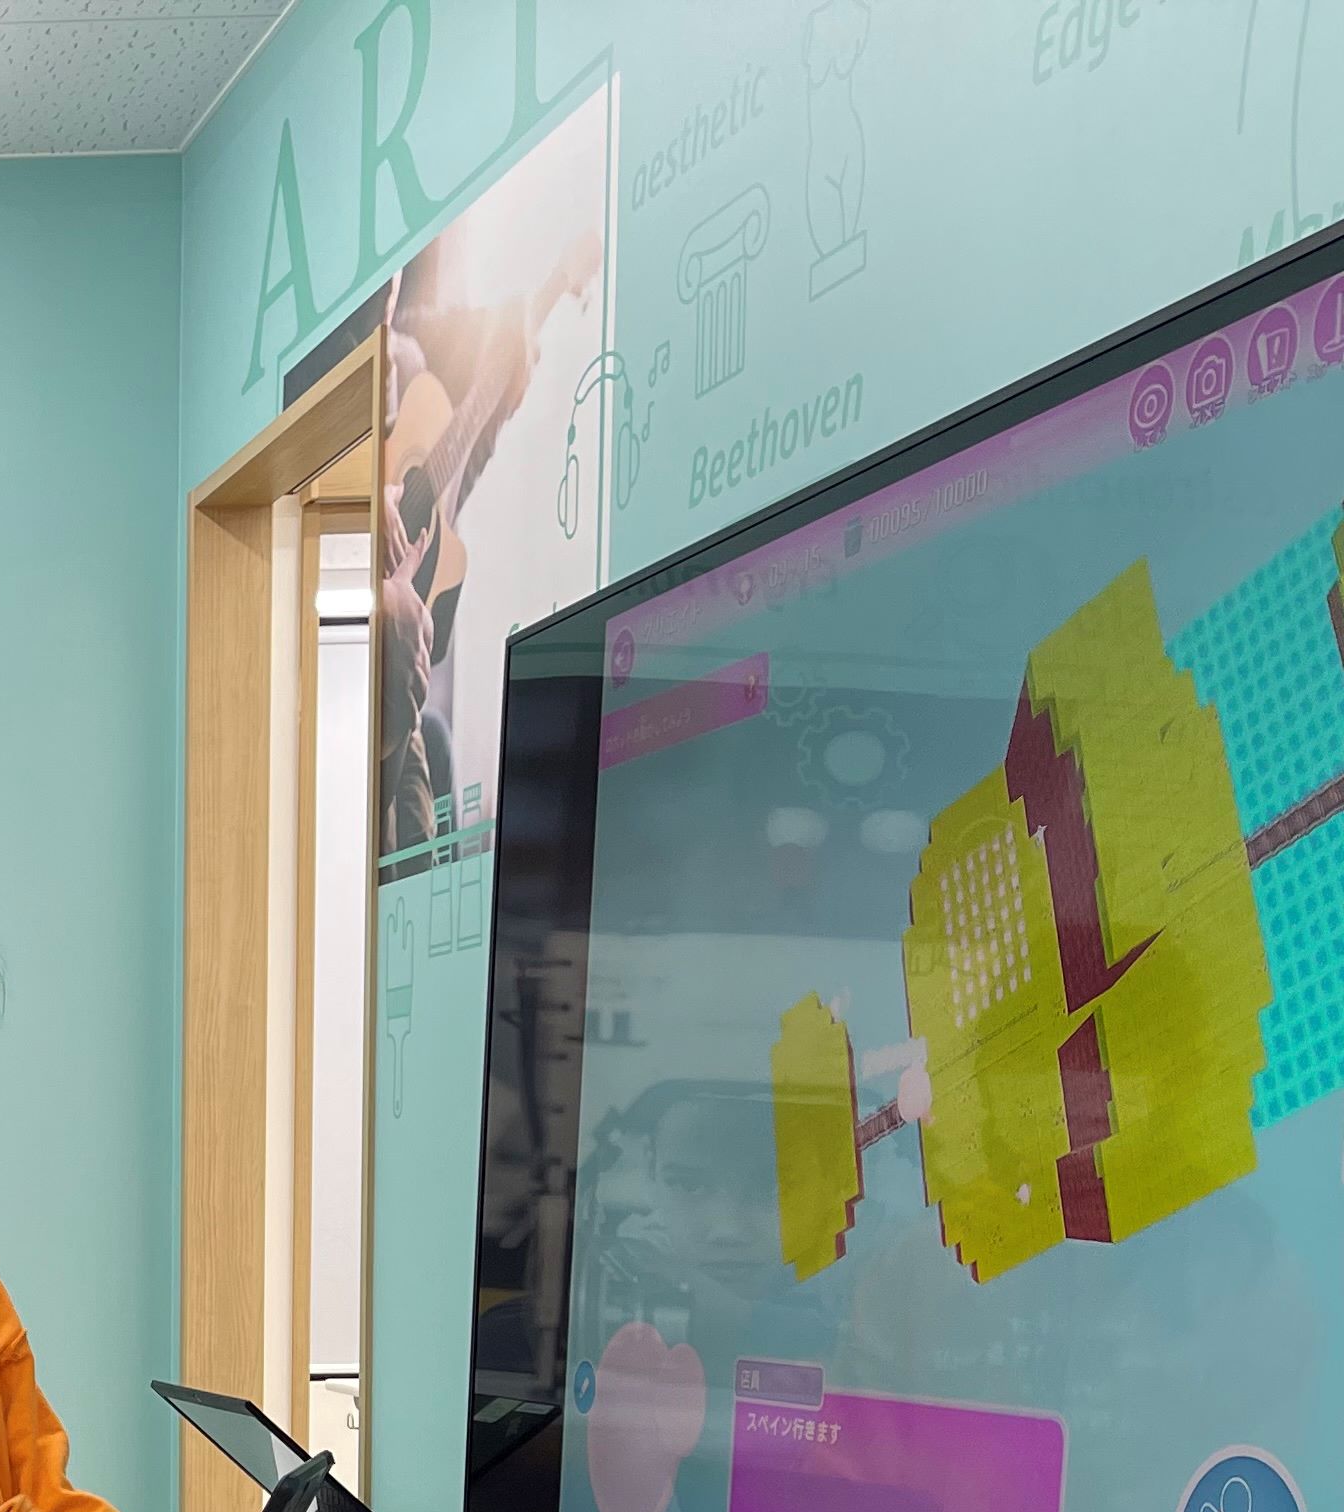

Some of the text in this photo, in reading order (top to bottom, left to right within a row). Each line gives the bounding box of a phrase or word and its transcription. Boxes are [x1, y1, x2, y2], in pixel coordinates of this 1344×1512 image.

[631, 62, 768, 212] aesthetic
[688, 373, 863, 509] Beethoven
[747, 1413, 842, 1444] スペイン行きます
